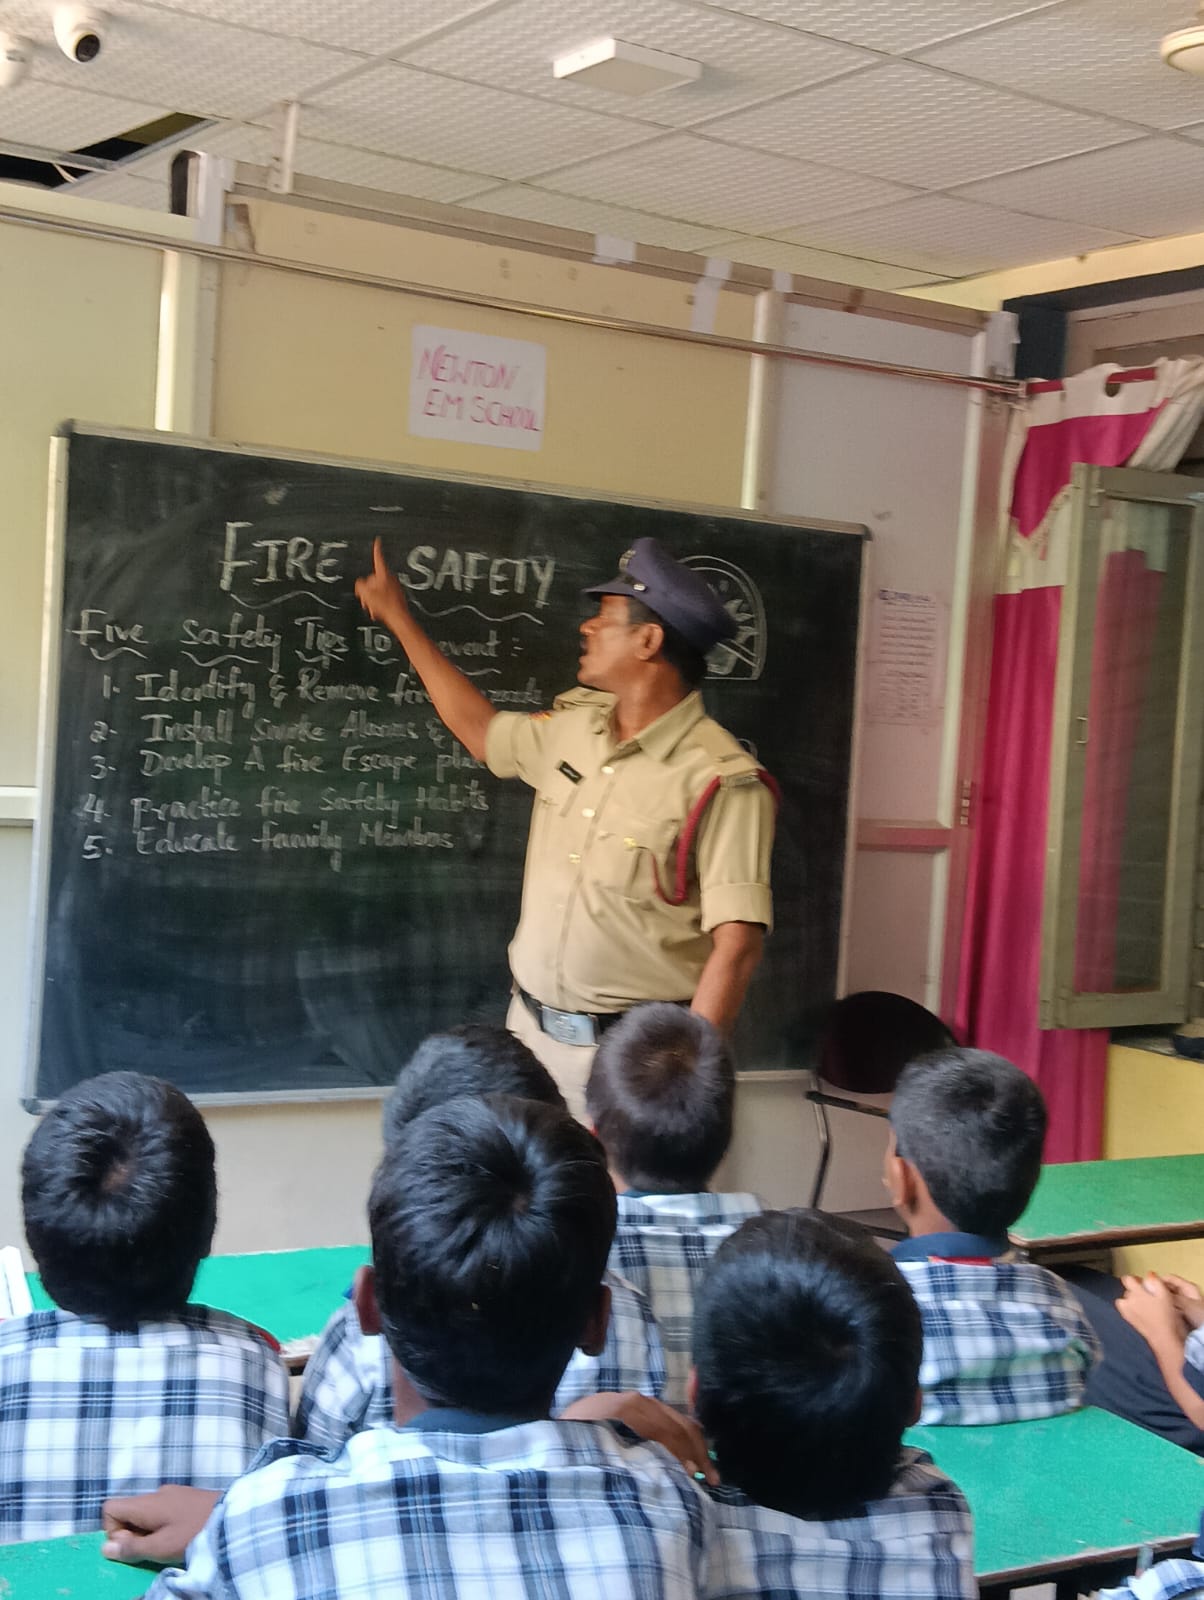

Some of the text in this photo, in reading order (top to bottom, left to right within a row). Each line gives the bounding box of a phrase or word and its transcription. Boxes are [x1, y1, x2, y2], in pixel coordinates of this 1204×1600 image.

[417, 345, 519, 390] NEWTON
[422, 388, 542, 432] EM SCHOOL
[218, 521, 555, 609] FIRE SAFETY
[66, 609, 149, 646] Five
[179, 612, 282, 673] Safety
[357, 626, 392, 652] To
[135, 666, 256, 719] Identify
[296, 667, 381, 703] Remove
[140, 710, 233, 744] Install
[251, 714, 328, 743] Smoke
[340, 709, 419, 739] Alarms
[244, 745, 266, 772] A
[276, 745, 327, 774] fire
[342, 745, 417, 781] Escape
[130, 786, 242, 834] Practice
[318, 782, 400, 830] Safety
[415, 779, 490, 813] Habits
[136, 821, 241, 856] Educate
[358, 816, 455, 849] Members
